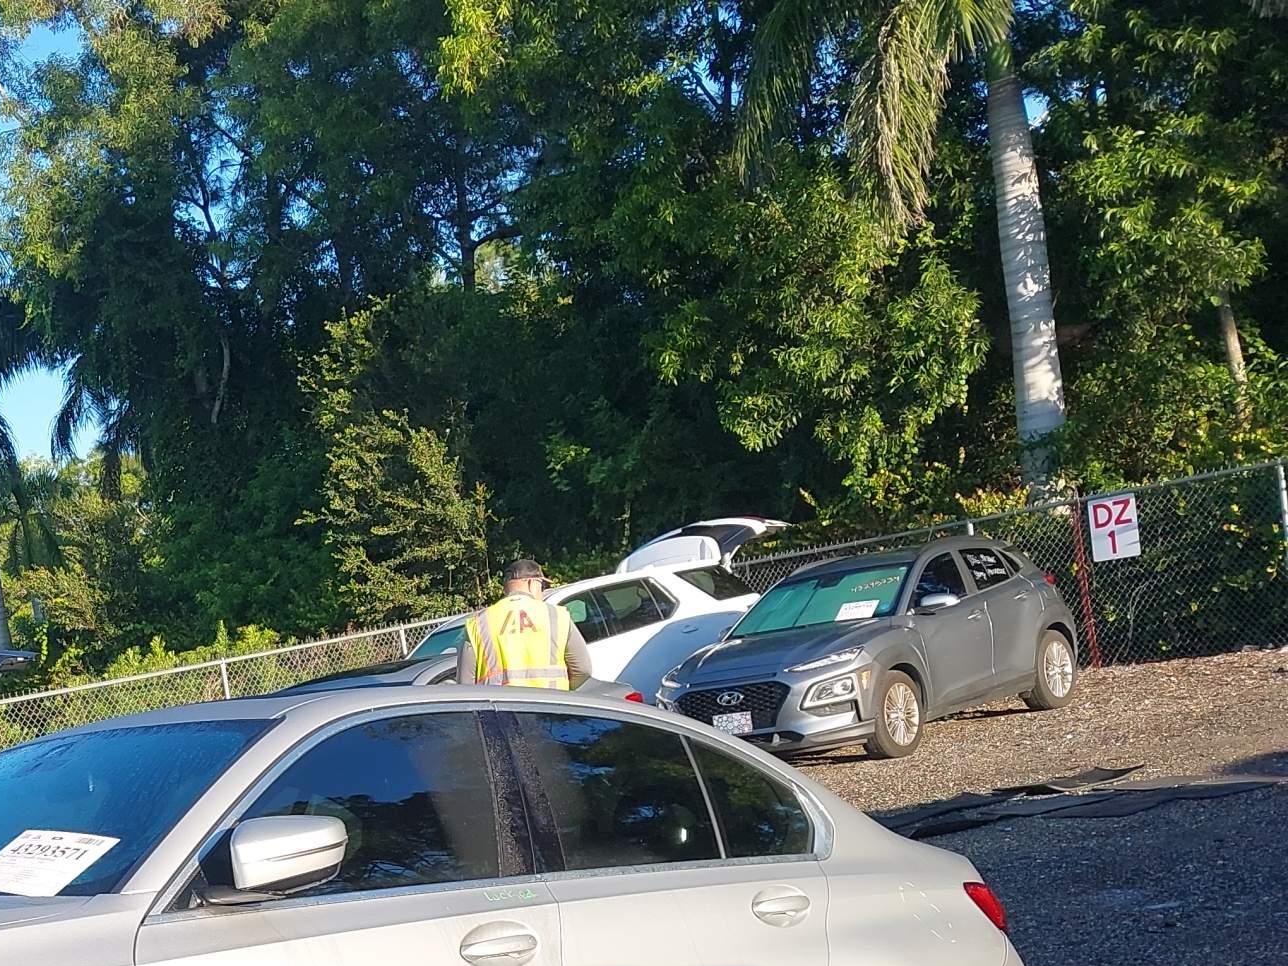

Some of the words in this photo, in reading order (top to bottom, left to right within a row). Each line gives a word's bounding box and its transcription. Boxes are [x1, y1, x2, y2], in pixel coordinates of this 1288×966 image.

[1093, 498, 1133, 529] DZ
[1107, 530, 1117, 554] 1
[10, 843, 90, 861] 43293571
